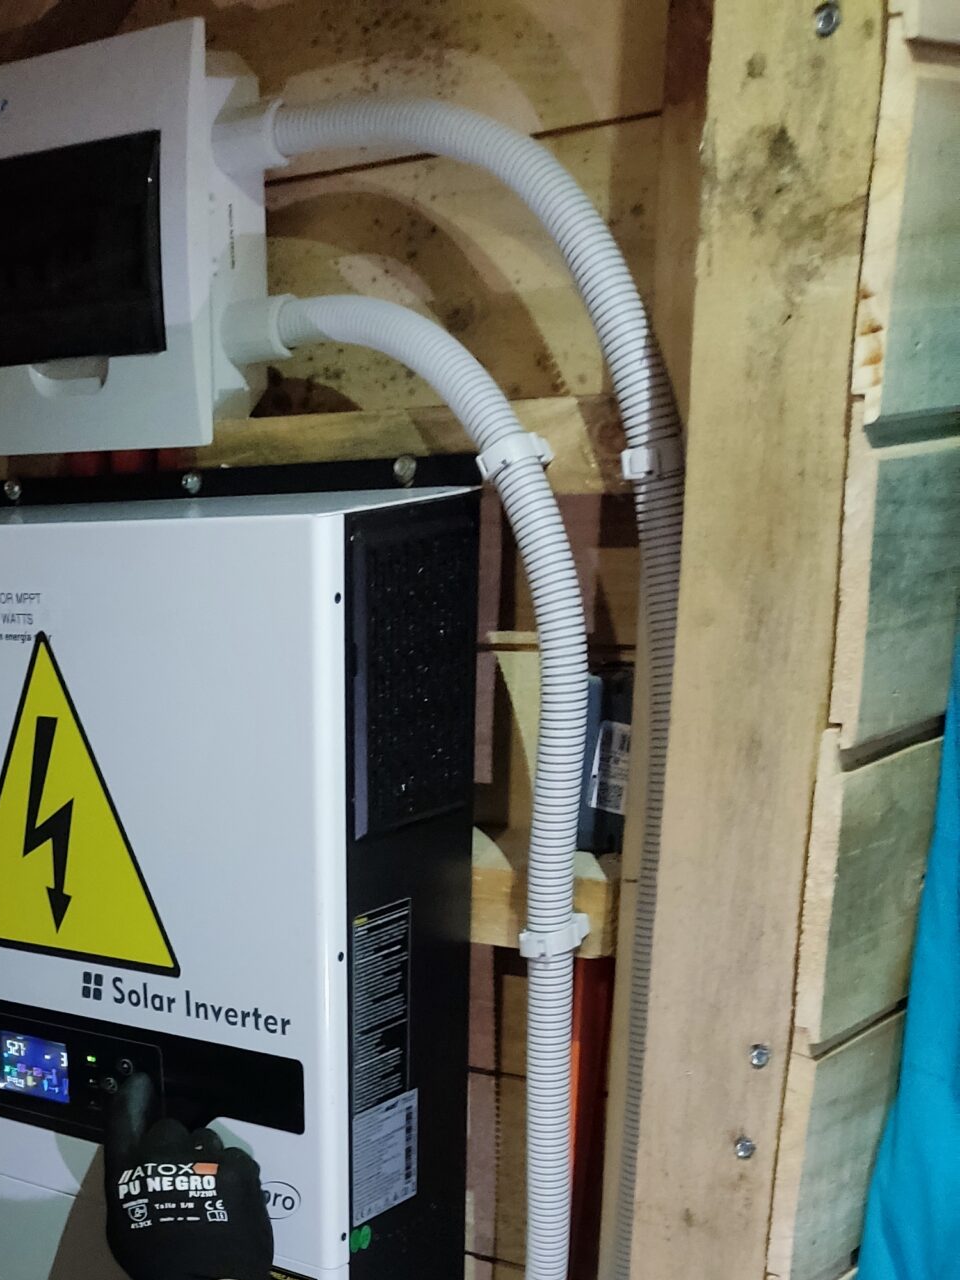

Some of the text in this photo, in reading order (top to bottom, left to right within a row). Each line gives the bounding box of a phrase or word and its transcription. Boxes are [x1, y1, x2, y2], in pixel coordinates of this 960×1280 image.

[15, 592, 41, 604] MPPT
[1, 612, 34, 625] WATTS
[112, 976, 292, 1036] Solar Inverter
[118, 1175, 216, 1200] PU NEGRO
